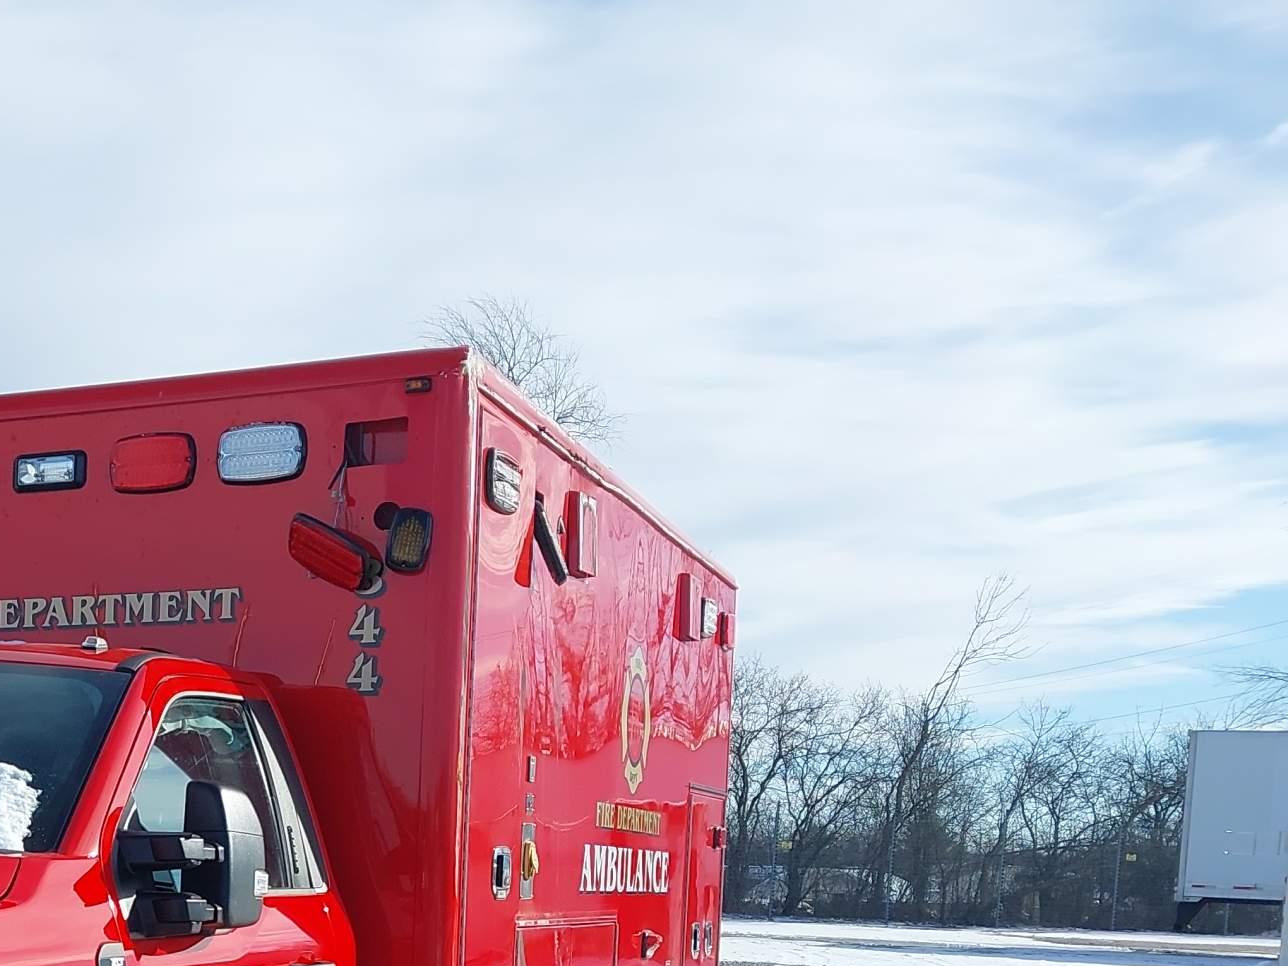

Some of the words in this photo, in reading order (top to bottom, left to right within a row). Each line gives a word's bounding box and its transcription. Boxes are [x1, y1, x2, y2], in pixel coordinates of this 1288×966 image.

[346, 575, 385, 694] 44
[596, 801, 616, 829] FIRE
[616, 805, 661, 836] DEPARTMENT
[579, 844, 669, 893] AMBULANCE
